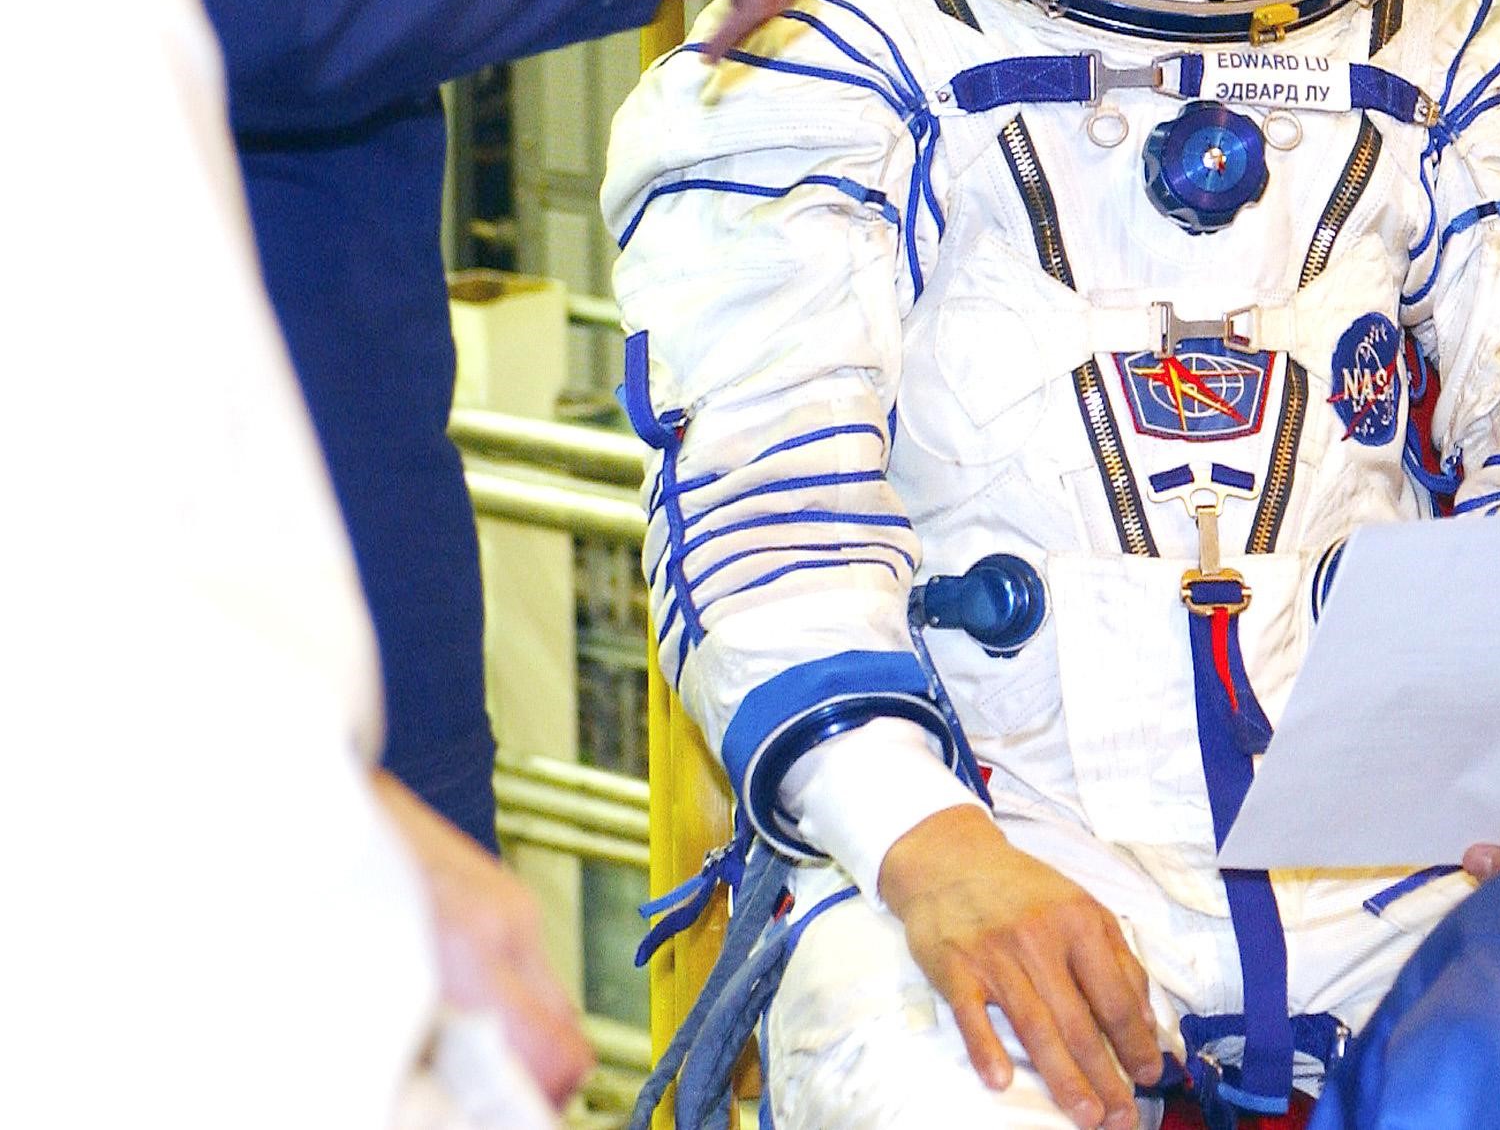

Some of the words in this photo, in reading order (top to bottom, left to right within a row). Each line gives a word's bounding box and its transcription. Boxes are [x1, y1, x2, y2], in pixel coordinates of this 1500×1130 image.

[1217, 52, 1300, 71] EDWARD
[1304, 56, 1330, 72] LU
[1216, 82, 1299, 104] ЭДВАРД
[1304, 85, 1331, 102] ЛУ
[1342, 367, 1394, 403] NASA
